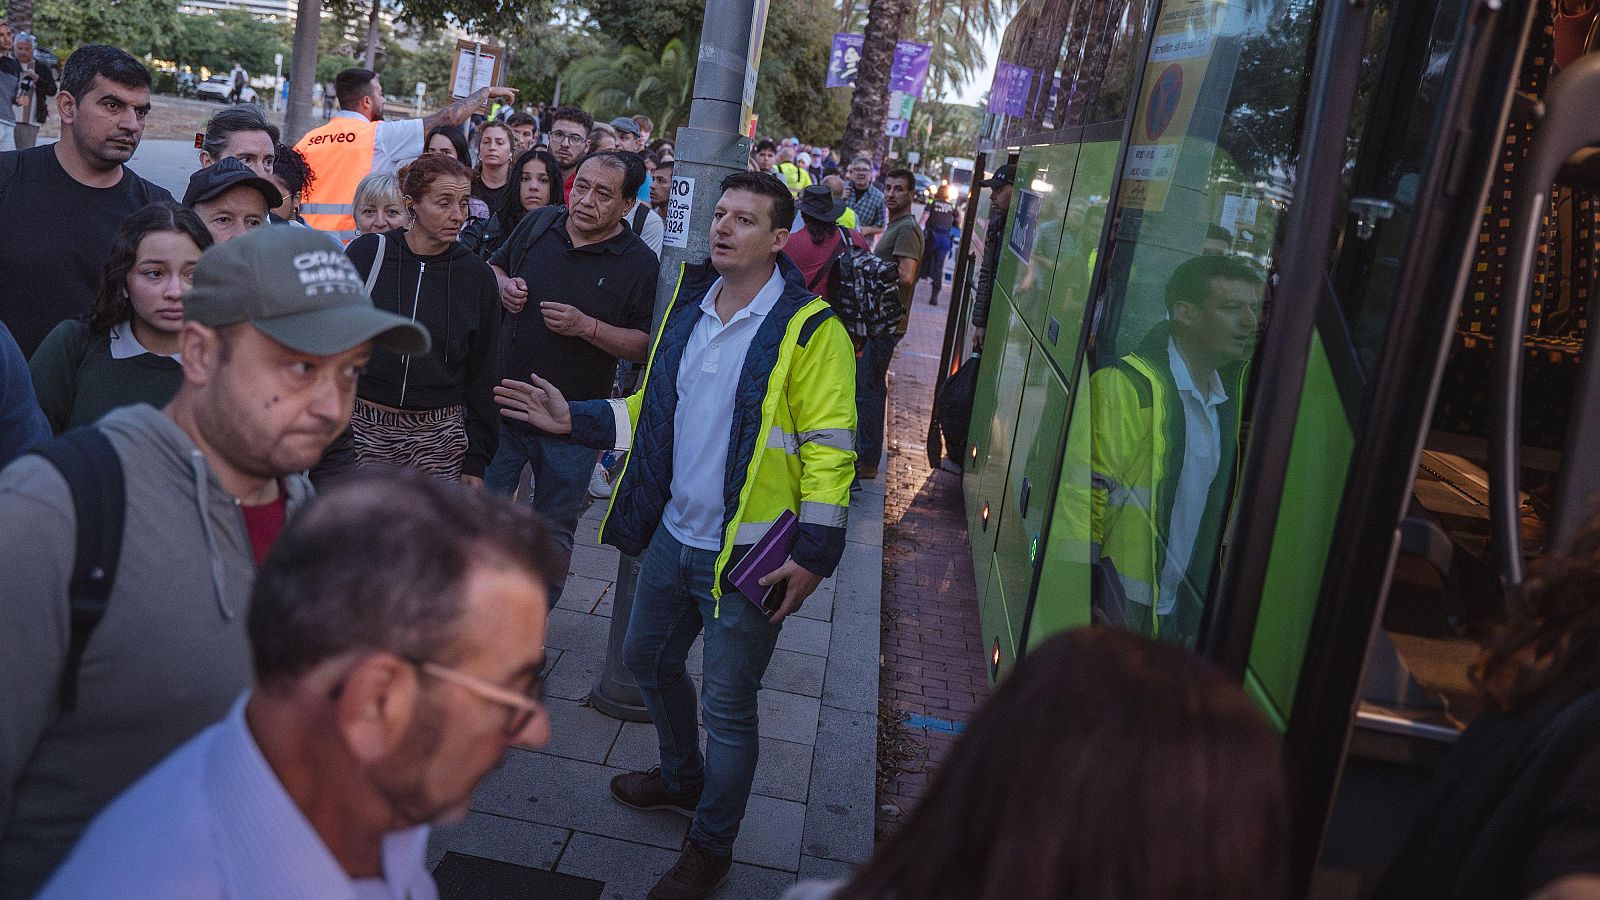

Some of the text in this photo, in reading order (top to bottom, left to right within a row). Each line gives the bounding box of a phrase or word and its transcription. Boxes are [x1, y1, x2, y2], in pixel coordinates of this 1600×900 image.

[308, 132, 356, 146] serveo
[672, 179, 690, 196] RO
[668, 210, 684, 219] LOS
